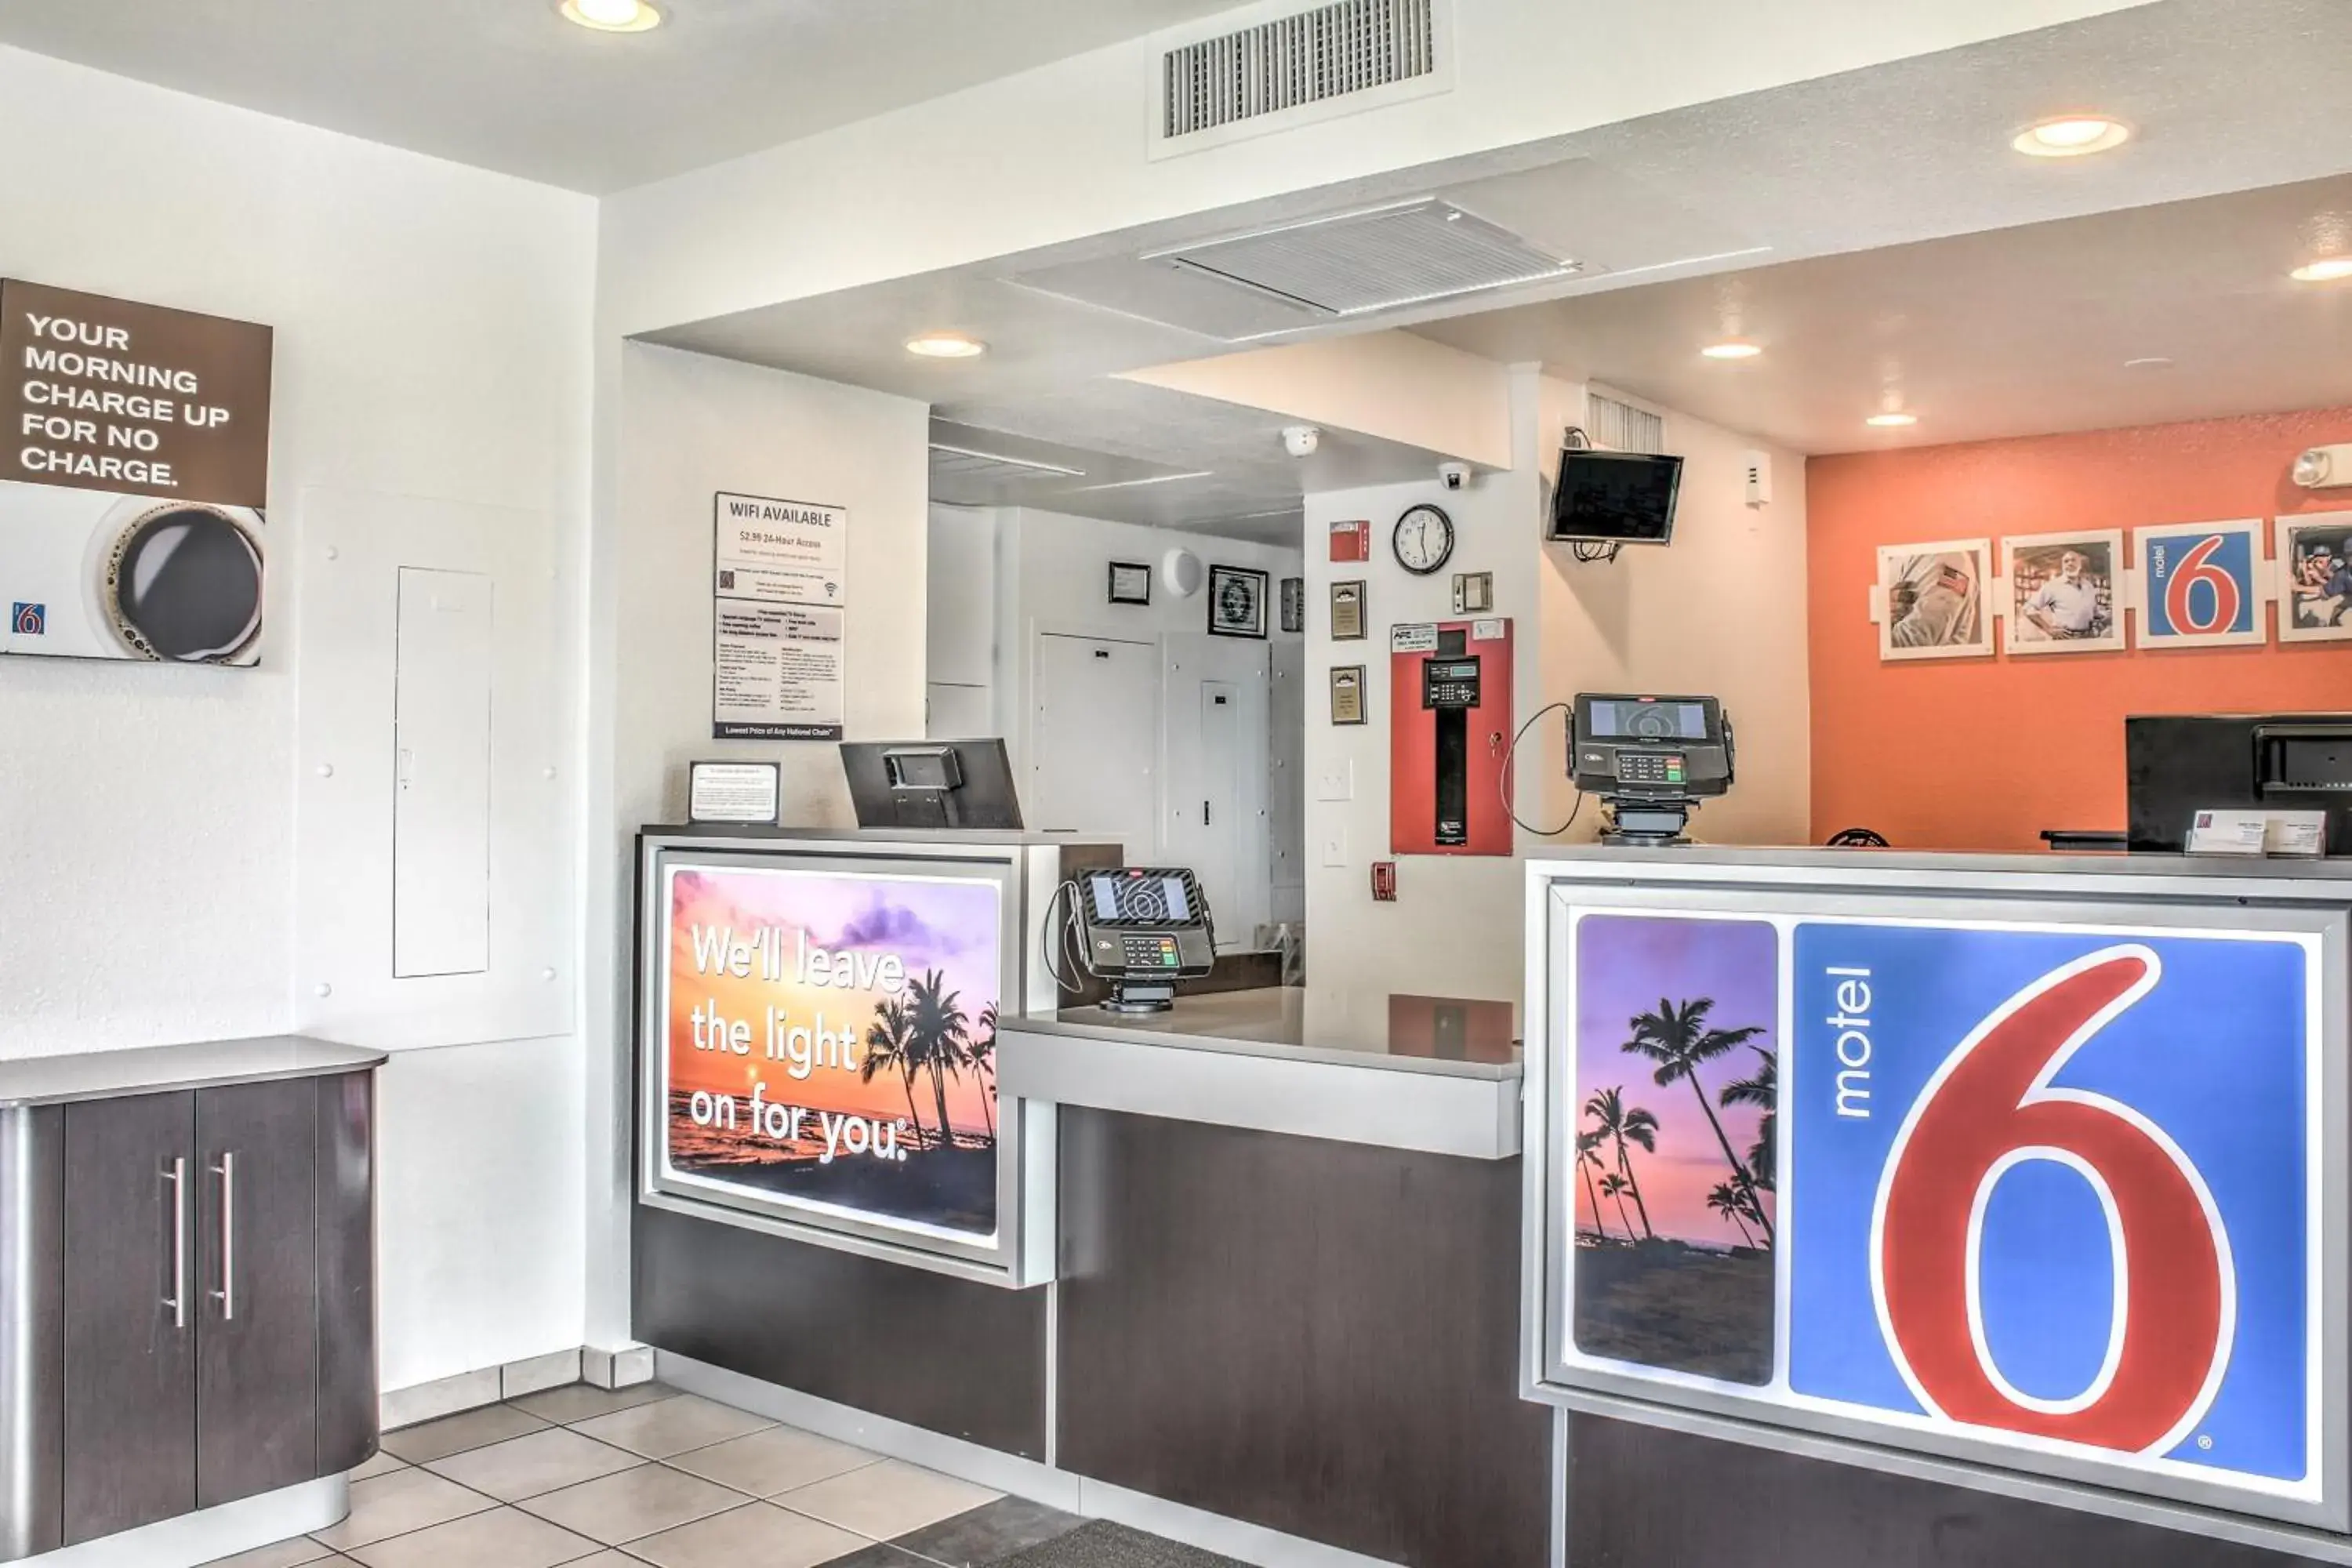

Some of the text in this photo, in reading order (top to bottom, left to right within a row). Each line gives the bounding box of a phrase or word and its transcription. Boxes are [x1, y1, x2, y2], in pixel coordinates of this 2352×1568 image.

[26, 313, 129, 351] YOUR
[25, 347, 198, 394] MORNING
[24, 380, 230, 428] CHARGE UP
[22, 413, 159, 452] FOR NO
[20, 447, 178, 487] CHARGE.
[730, 502, 832, 528] WIFI AVAILABLE
[2153, 535, 2240, 635] motel 6
[17, 602, 42, 633] 6
[1123, 878, 1163, 920] 6
[691, 923, 905, 993] We'll leave
[691, 998, 857, 1080] the light
[691, 1090, 735, 1130] on
[750, 1083, 807, 1142] for
[1826, 967, 1871, 1119] motel
[1869, 943, 2238, 1460] 6
